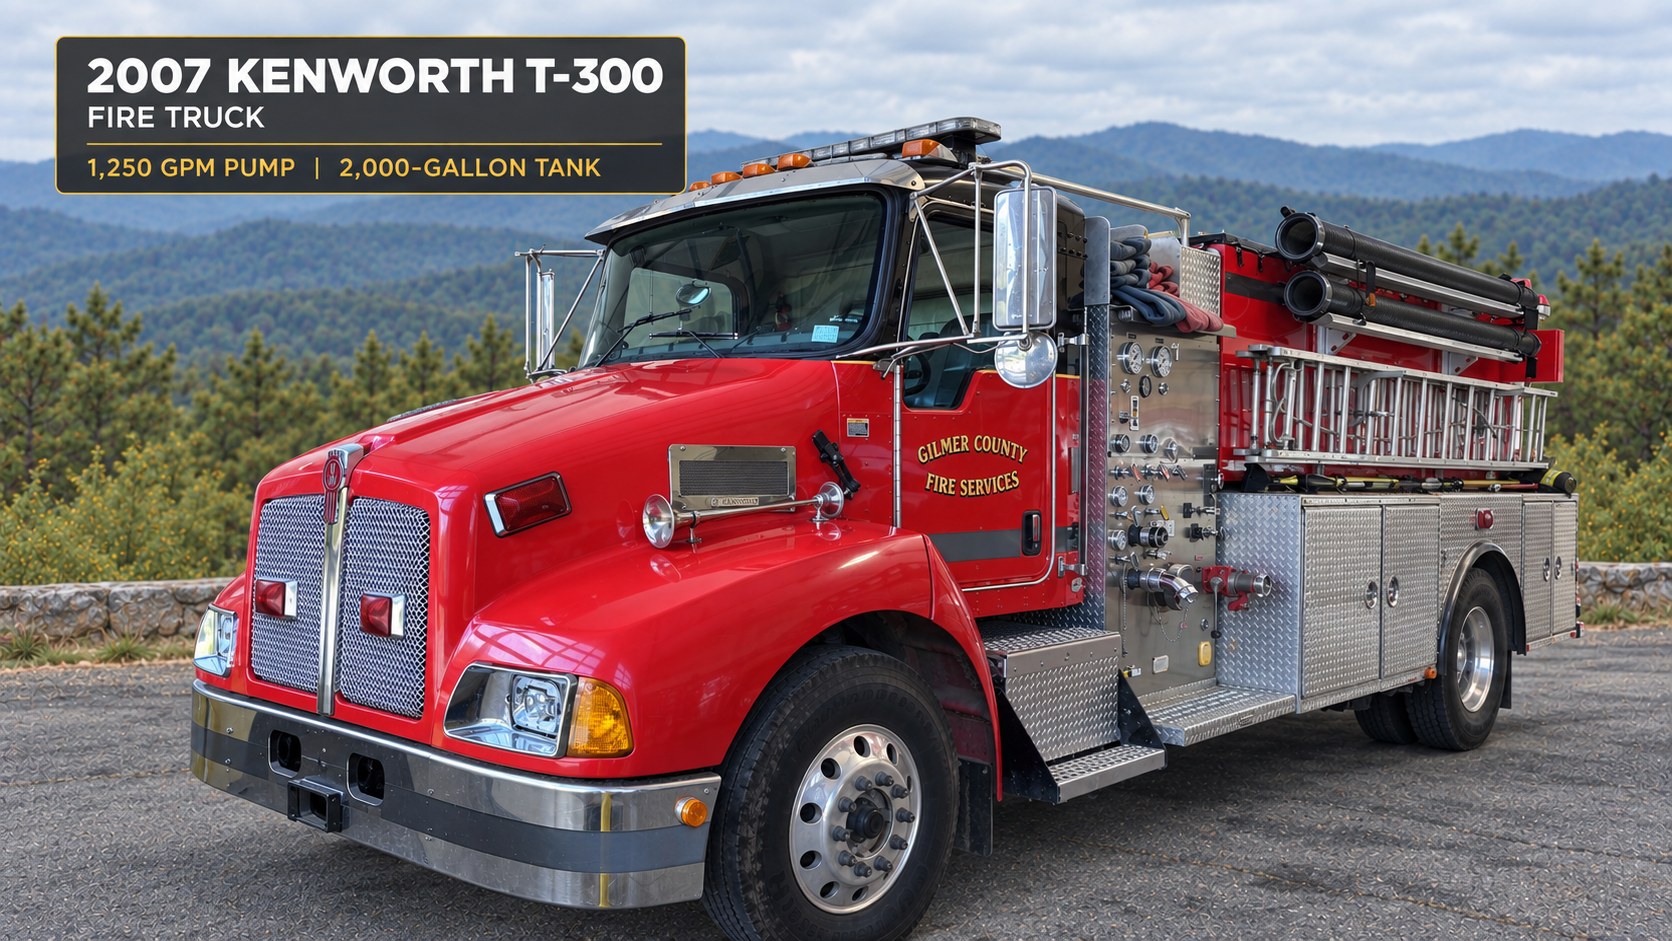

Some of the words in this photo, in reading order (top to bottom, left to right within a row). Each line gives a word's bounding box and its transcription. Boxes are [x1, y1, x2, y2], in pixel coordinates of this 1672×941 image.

[917, 435, 970, 464] GILMER
[973, 434, 1028, 464] COUNTY
[925, 472, 956, 495] FIRE
[960, 470, 1020, 497] SERVICES
